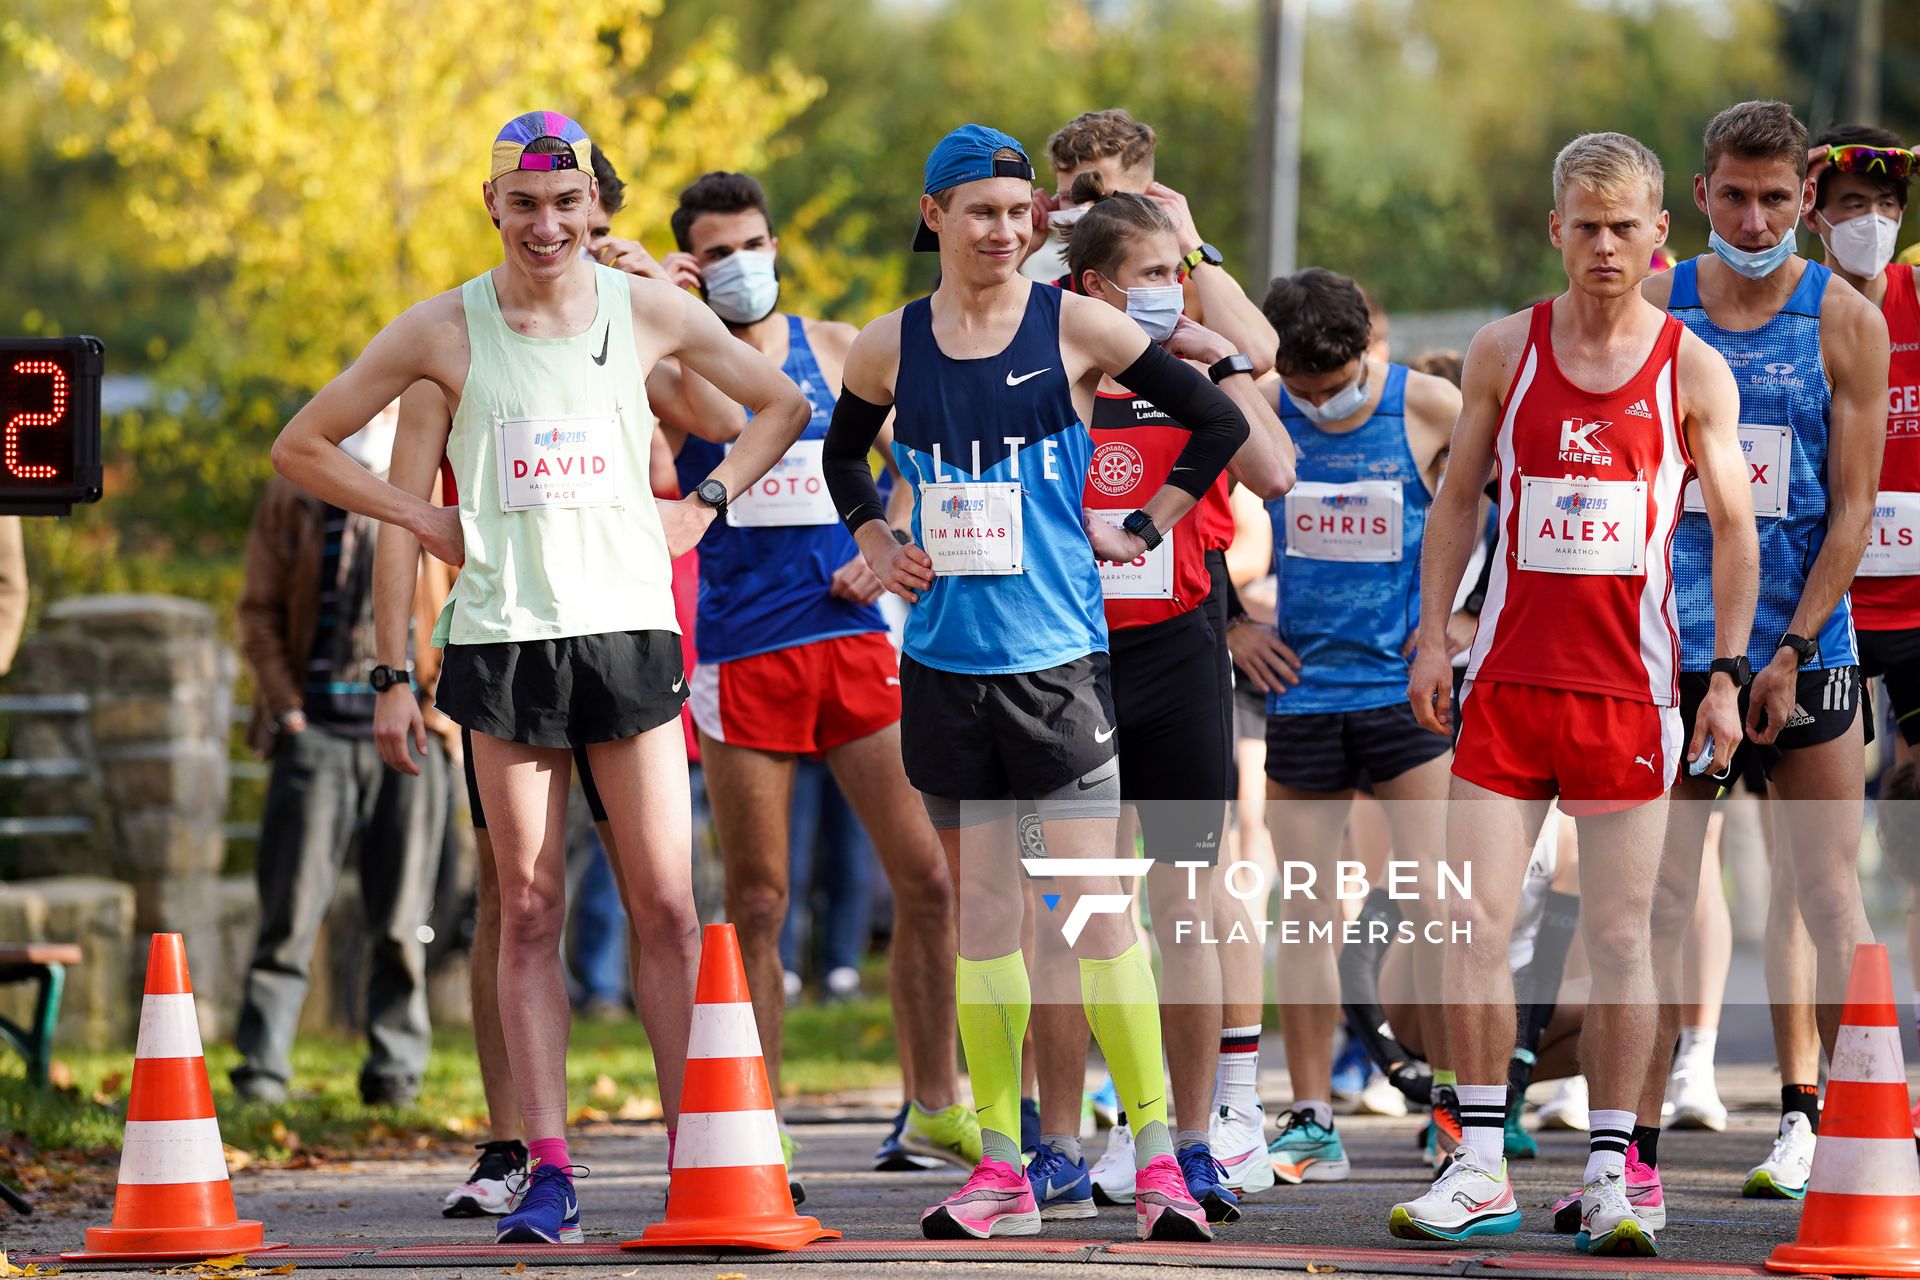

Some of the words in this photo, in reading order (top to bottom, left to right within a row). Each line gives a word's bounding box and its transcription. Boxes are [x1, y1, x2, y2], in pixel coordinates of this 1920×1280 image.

[1751, 374, 1780, 385] Berlin
[5, 361, 69, 478] 2
[1625, 408, 1652, 419] adidas
[1558, 451, 1613, 467] KIEFER
[513, 455, 606, 479] DAVID
[546, 490, 577, 500] PACE
[1296, 514, 1388, 535] CHRIS
[1538, 518, 1621, 542] ALEX
[929, 528, 948, 539] TIM
[953, 527, 1007, 538] NIKLAS
[938, 549, 989, 557] HALBMARATHON
[1555, 547, 1600, 556] MARATHON
[1785, 715, 1816, 729] adidas
